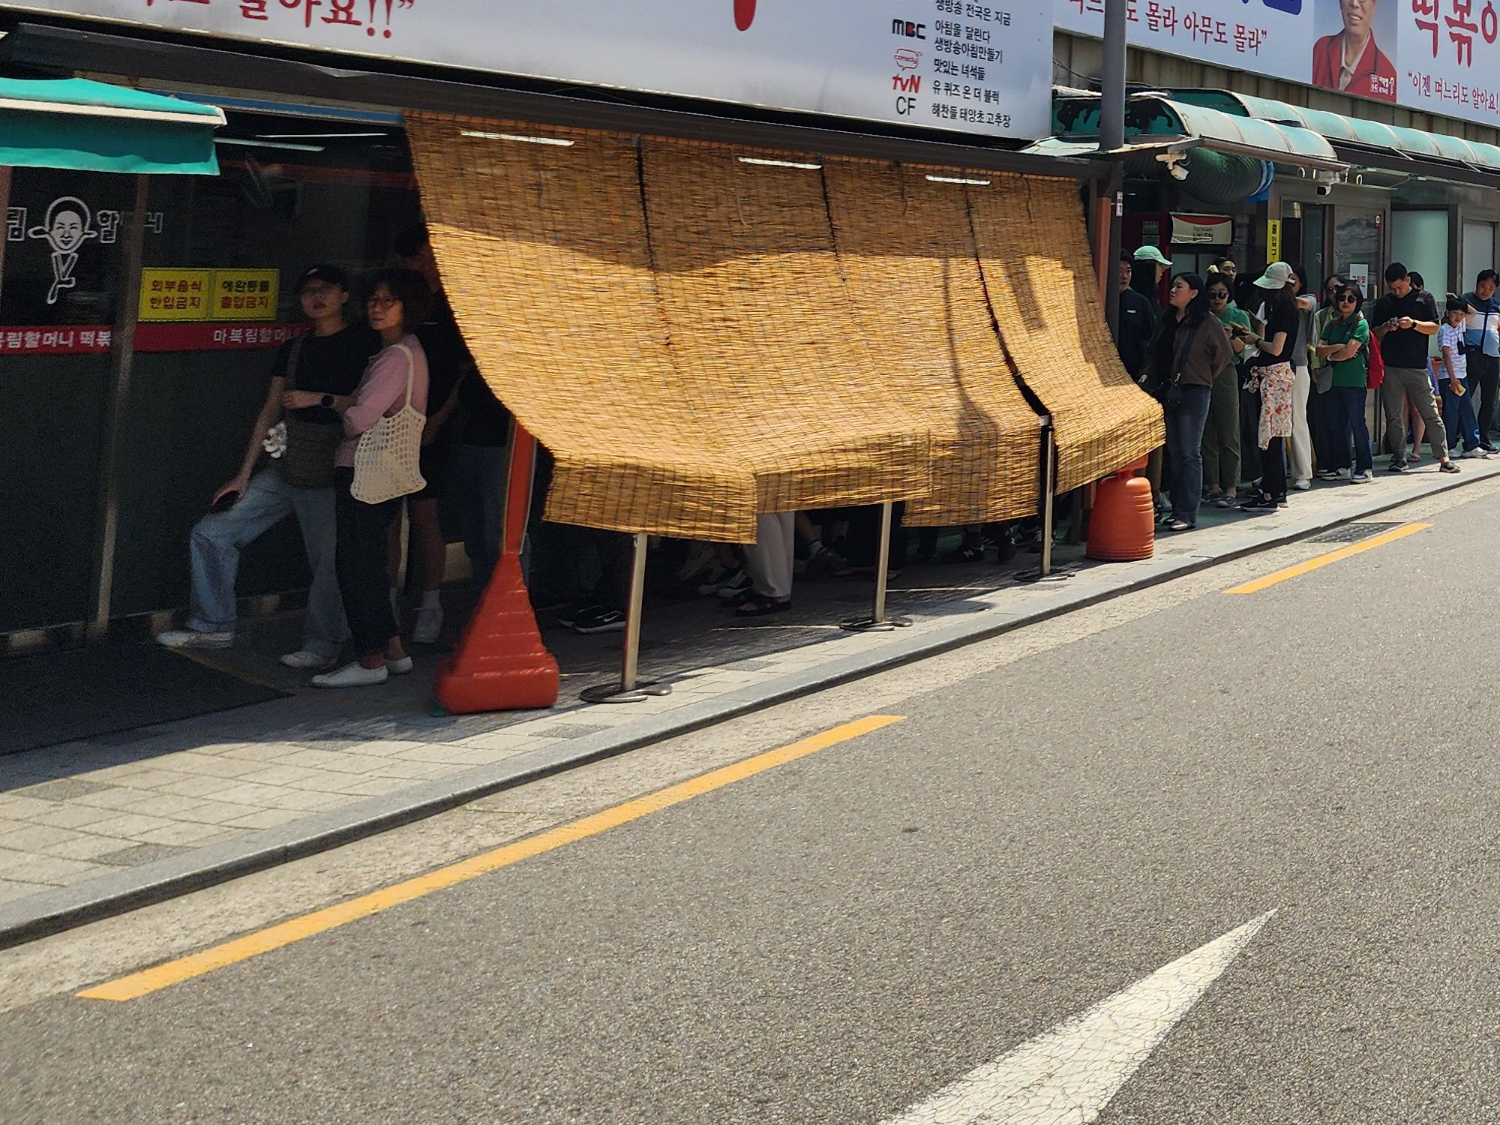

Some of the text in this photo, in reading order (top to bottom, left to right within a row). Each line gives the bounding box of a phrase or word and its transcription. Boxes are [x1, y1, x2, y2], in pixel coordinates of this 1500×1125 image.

[935, 20, 961, 37] 아침을
[1145, 1, 1178, 37] 몰라
[1183, 11, 1228, 45] 아무도
[933, 58, 959, 76] 맛있는
[892, 74, 921, 93] tvN
[1434, 77, 1469, 105] 며느리도
[896, 95, 917, 116] CF
